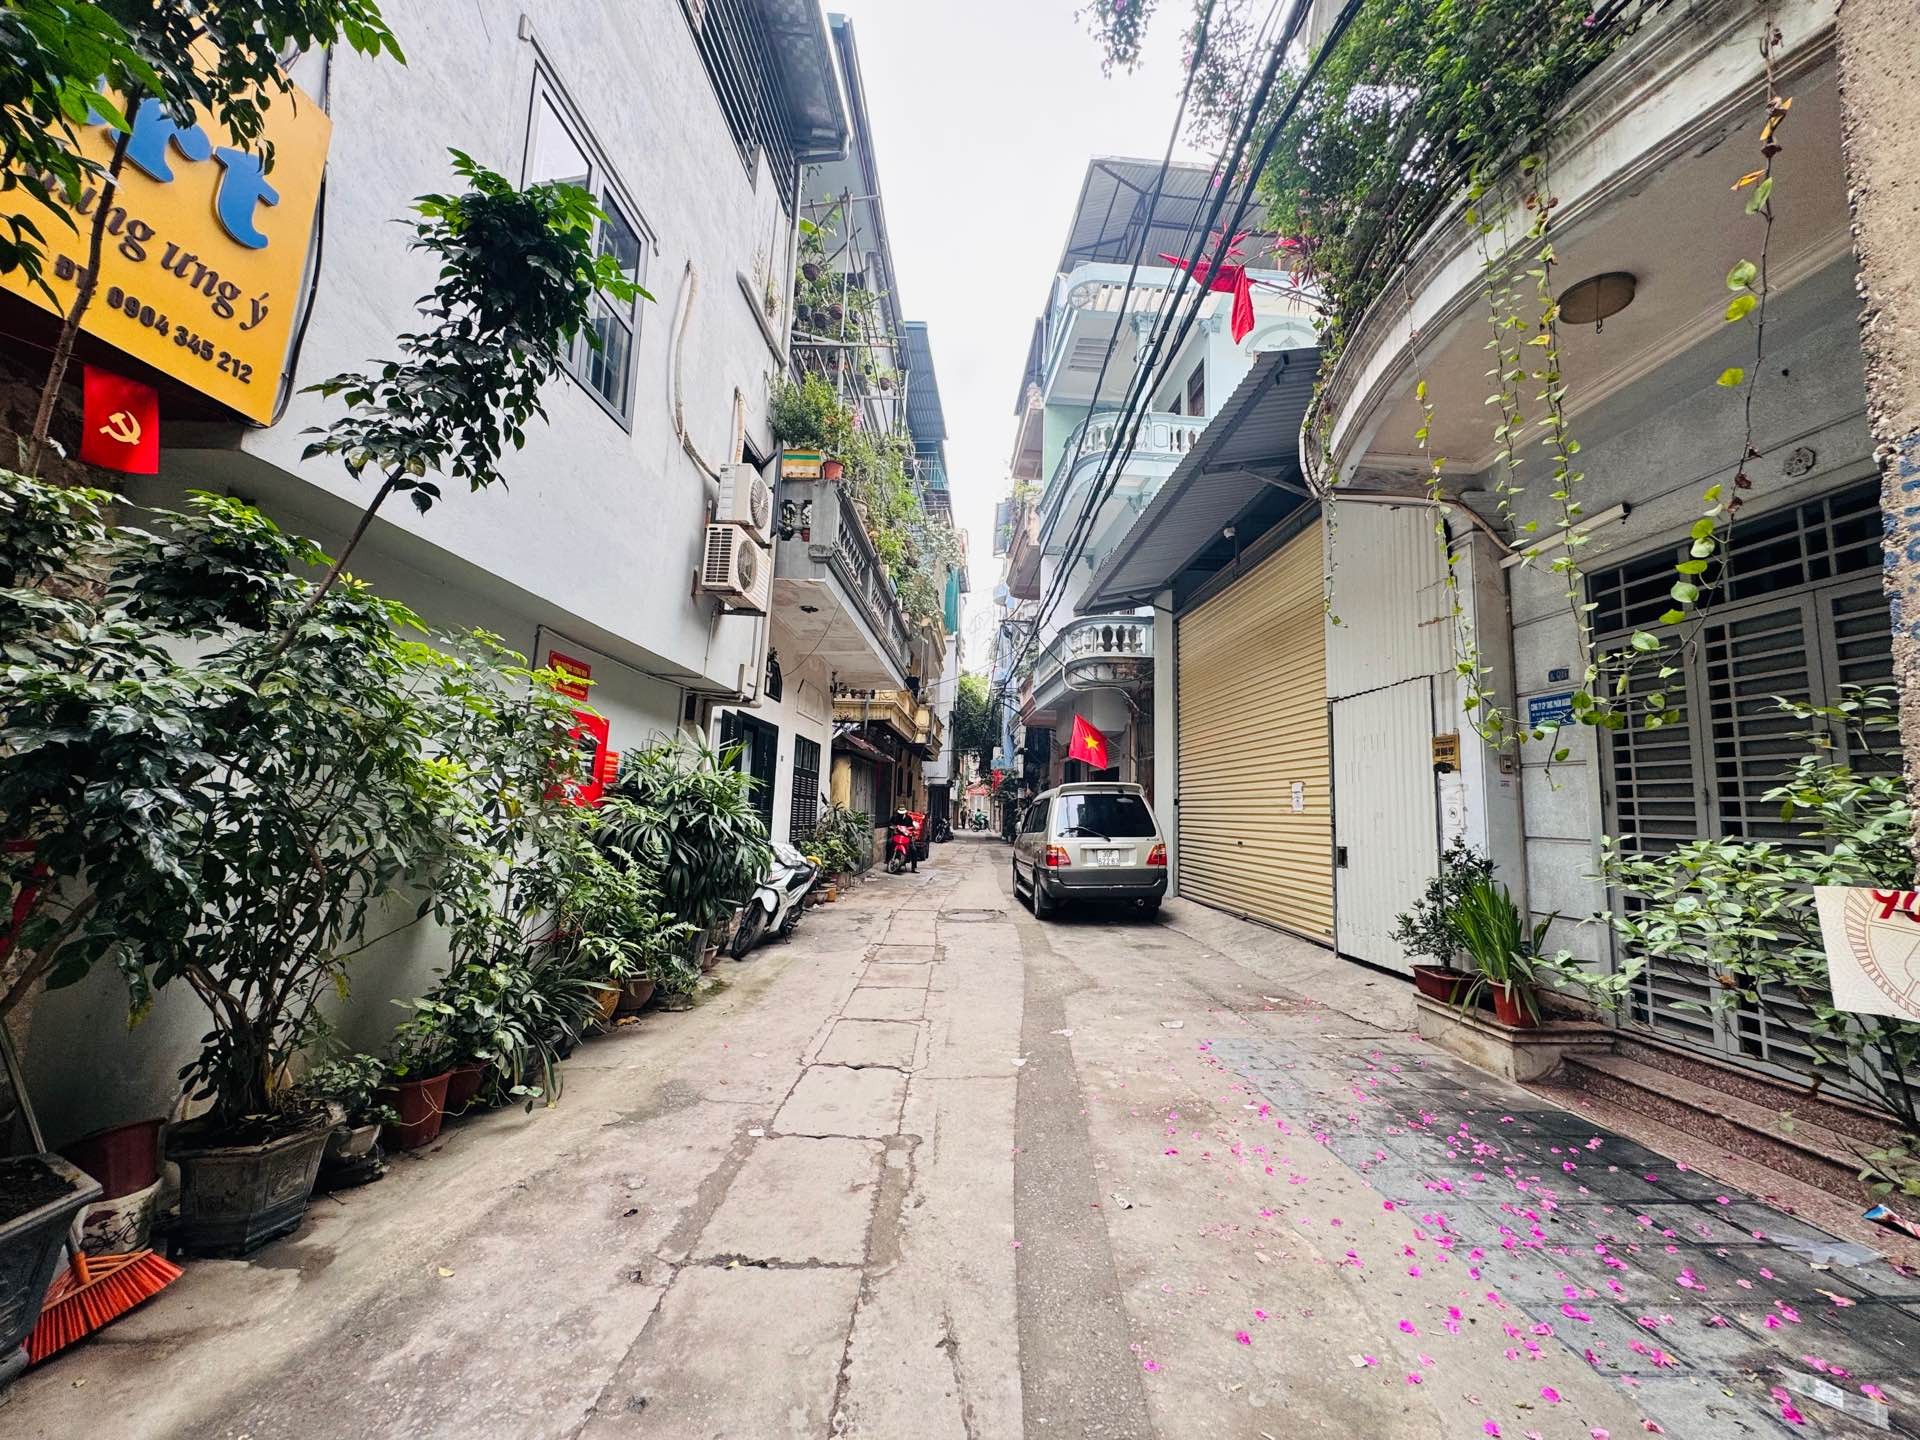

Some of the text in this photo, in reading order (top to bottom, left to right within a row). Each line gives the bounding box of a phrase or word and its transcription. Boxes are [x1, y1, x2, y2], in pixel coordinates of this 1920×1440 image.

[85, 73, 279, 249] rt
[160, 239, 242, 319] ưng
[240, 292, 270, 331] ý
[107, 286, 169, 338] 0904
[173, 324, 215, 364] 345
[217, 350, 254, 384] 212
